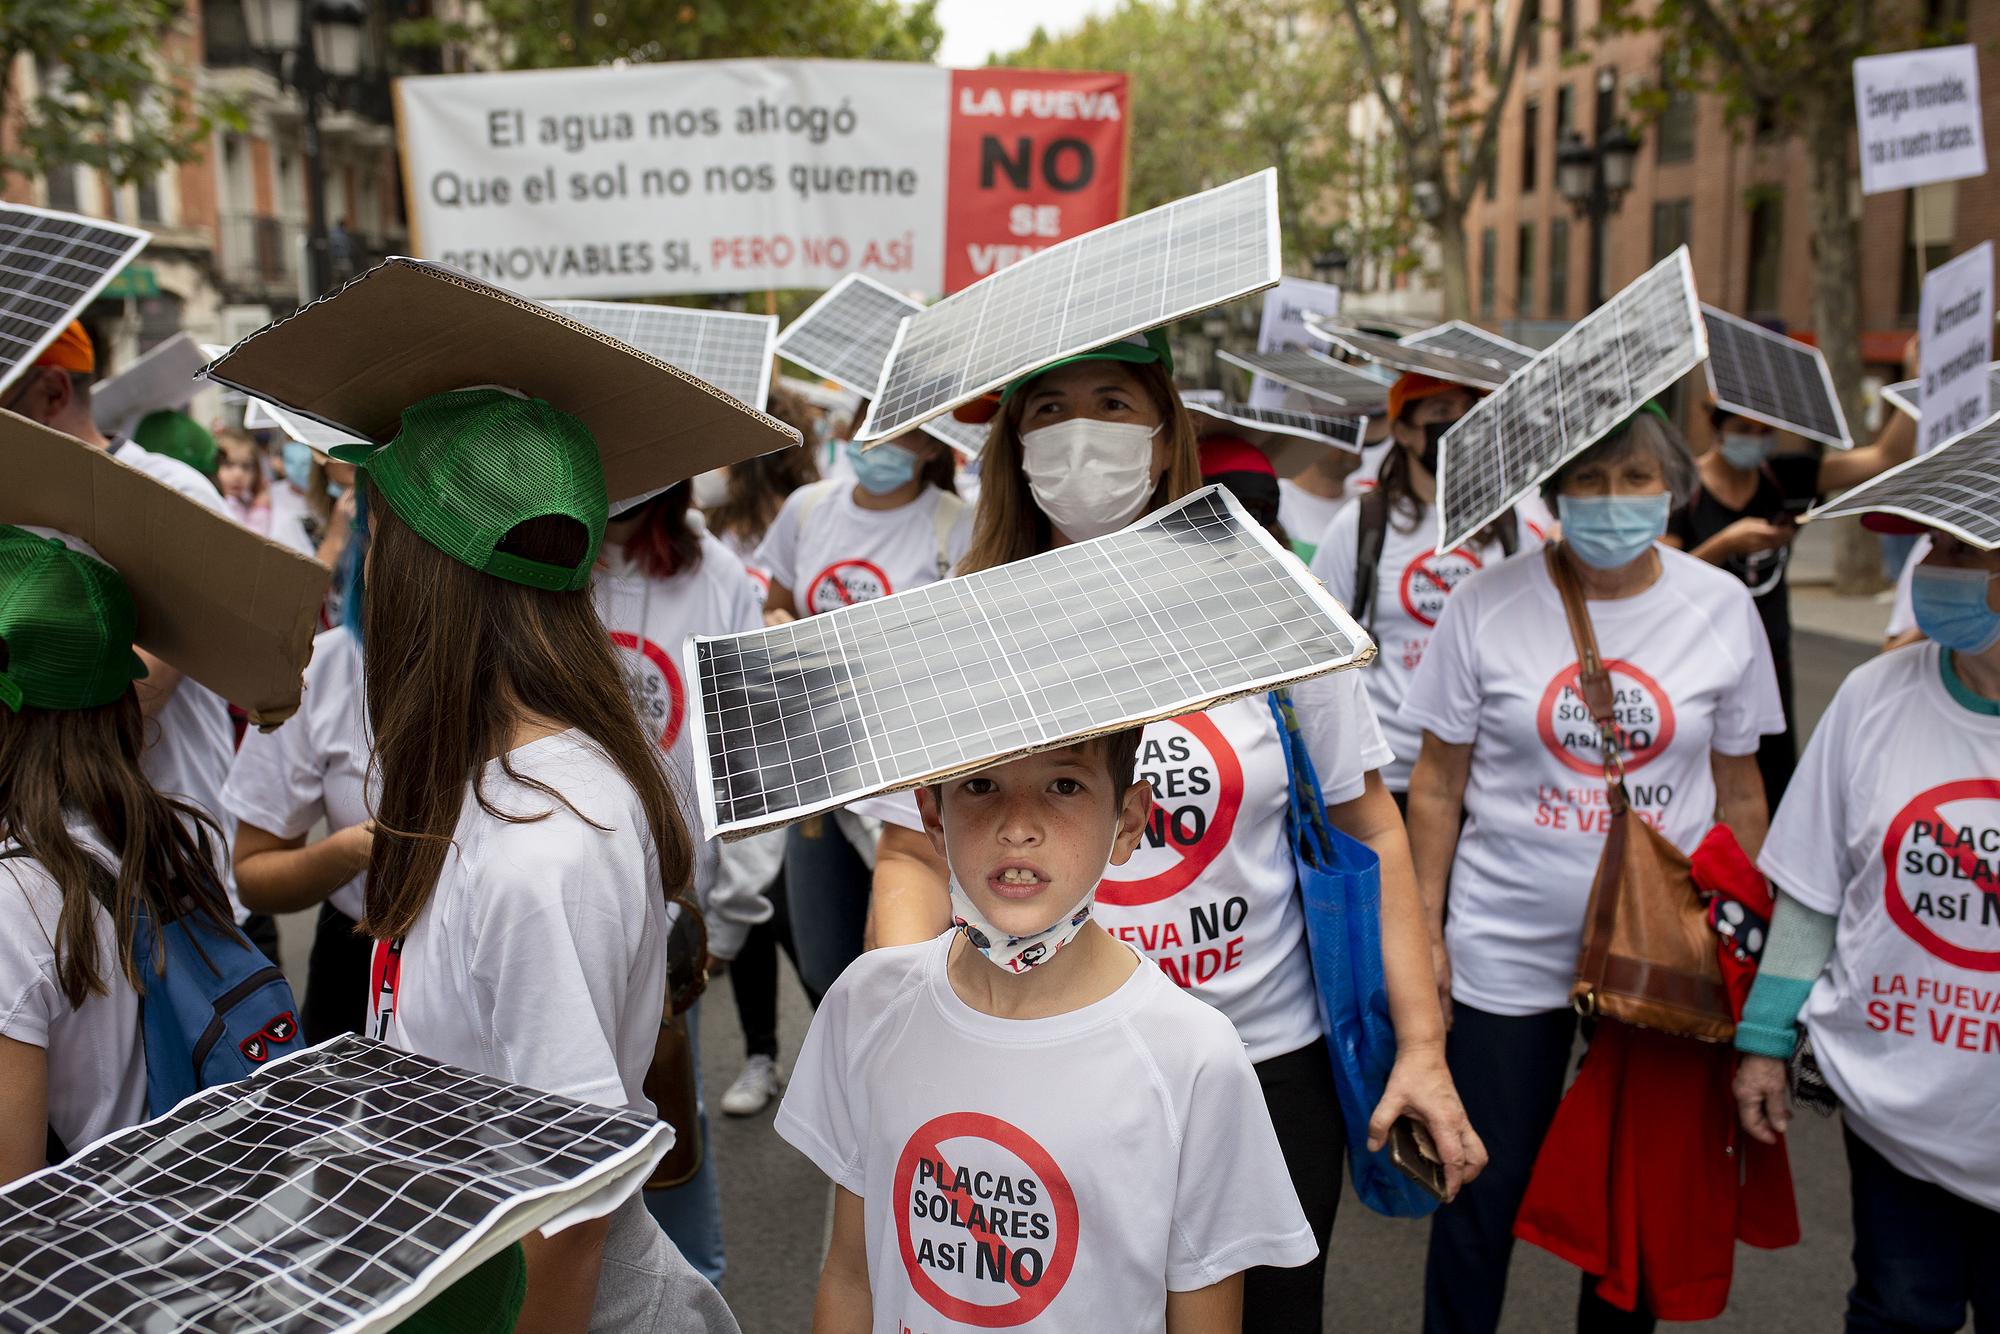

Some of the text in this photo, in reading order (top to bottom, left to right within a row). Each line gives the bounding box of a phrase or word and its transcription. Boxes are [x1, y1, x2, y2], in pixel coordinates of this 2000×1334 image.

[488, 97, 857, 153] El agua nos ahogó
[959, 87, 1121, 122] LA FUEVA
[979, 134, 1095, 193] NO
[431, 162, 918, 210] Que el sol no nos queme
[1009, 203, 1060, 237] SE
[710, 234, 795, 271] PERO
[803, 236, 850, 270] NO
[860, 230, 914, 272] ASÍ
[1535, 802, 1568, 829] SE
[1538, 784, 1563, 803] LA
[1634, 784, 1673, 806] NO
[1189, 896, 1248, 945] NO
[1914, 892, 1970, 922] ASÍ
[1873, 975, 1907, 996] LA
[1866, 1000, 1915, 1036] SE
[919, 1157, 1037, 1206] PLACAS
[913, 1190, 1050, 1240] SOLARES
[916, 1238, 1043, 1287] ASÍ NO
